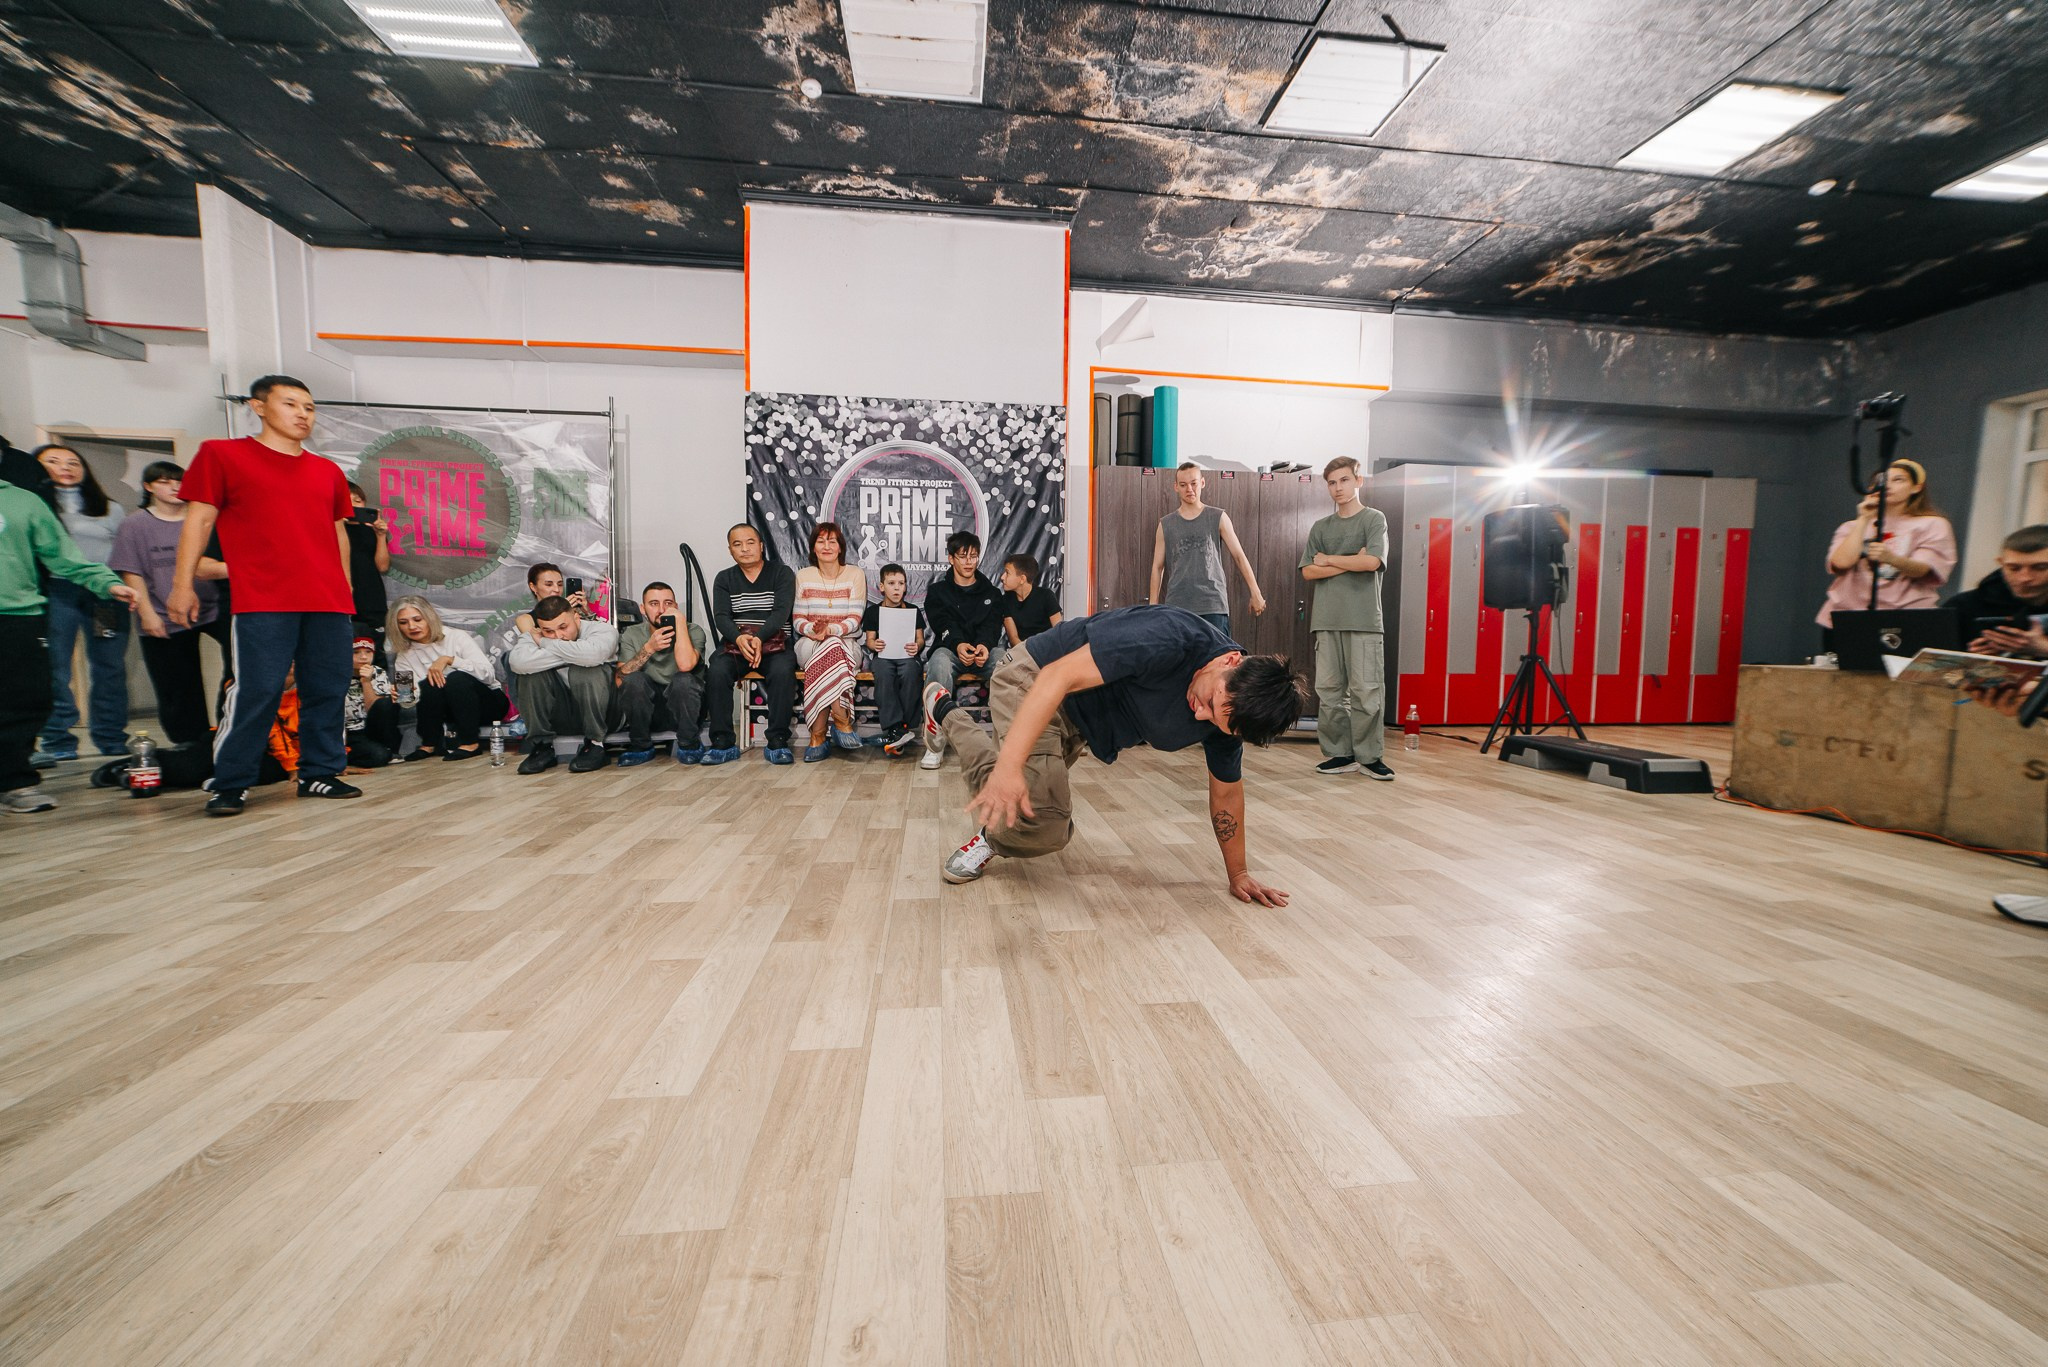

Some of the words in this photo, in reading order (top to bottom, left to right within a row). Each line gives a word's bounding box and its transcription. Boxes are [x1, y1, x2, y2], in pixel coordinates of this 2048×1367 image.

[861, 478, 886, 486] TREND
[888, 479, 918, 487] FITNESS
[920, 480, 953, 488] PROJECT
